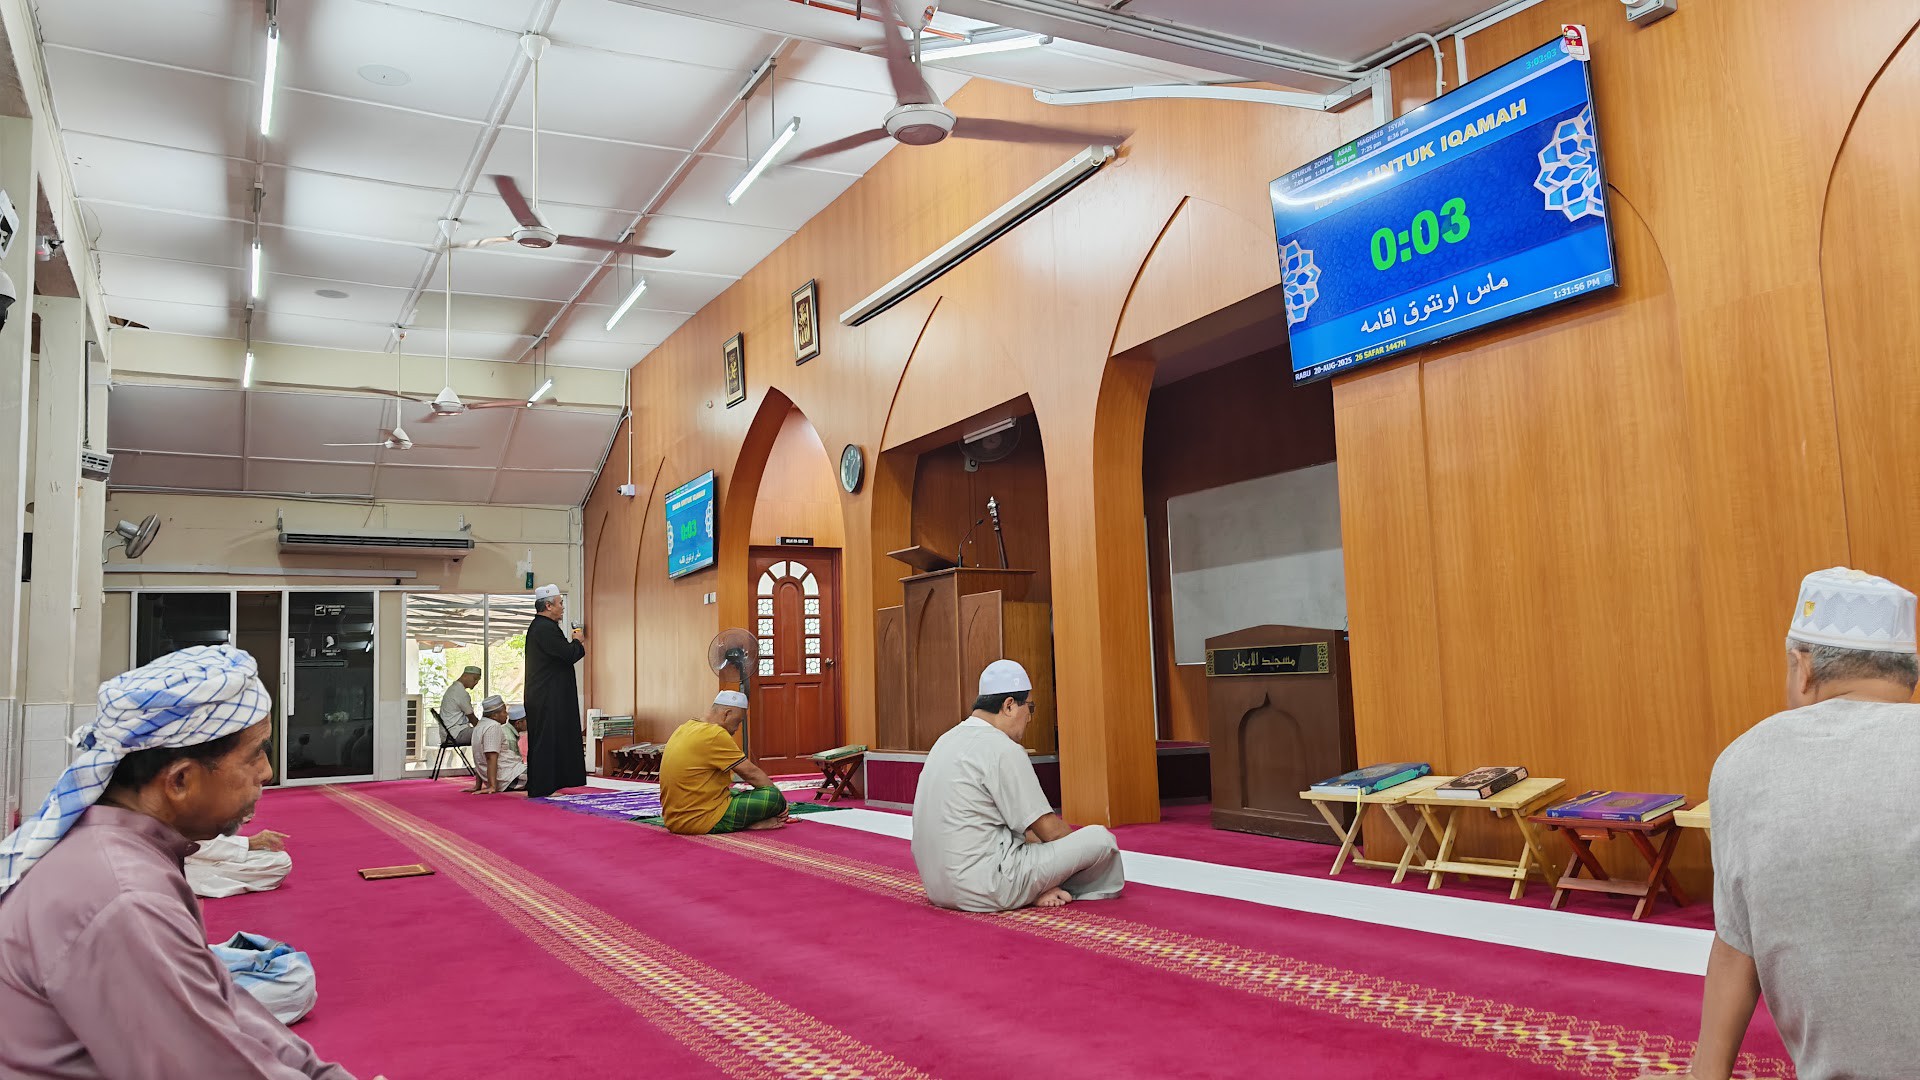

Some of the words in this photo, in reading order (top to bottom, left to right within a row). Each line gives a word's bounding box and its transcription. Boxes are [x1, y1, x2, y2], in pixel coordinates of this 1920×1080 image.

[1525, 48, 1557, 70] 3:02:03
[1356, 129, 1384, 148] MAGHRIB
[1387, 118, 1407, 133] ISYAK
[1366, 140, 1436, 180] UNTUK
[1440, 97, 1528, 153] IQAMAH
[1370, 197, 1471, 271] 0:03
[1466, 272, 1509, 305] ماس
[1553, 282, 1585, 299] 1:31:56
[1586, 277, 1600, 289] PM
[1294, 369, 1311, 381] RABU
[1313, 356, 1352, 375] 20-AUG-2025
[1354, 353, 1363, 362] 26
[1363, 346, 1385, 359] SAFAR
[1385, 339, 1407, 353] 1447H
[1261, 655, 1296, 668] مسجد
